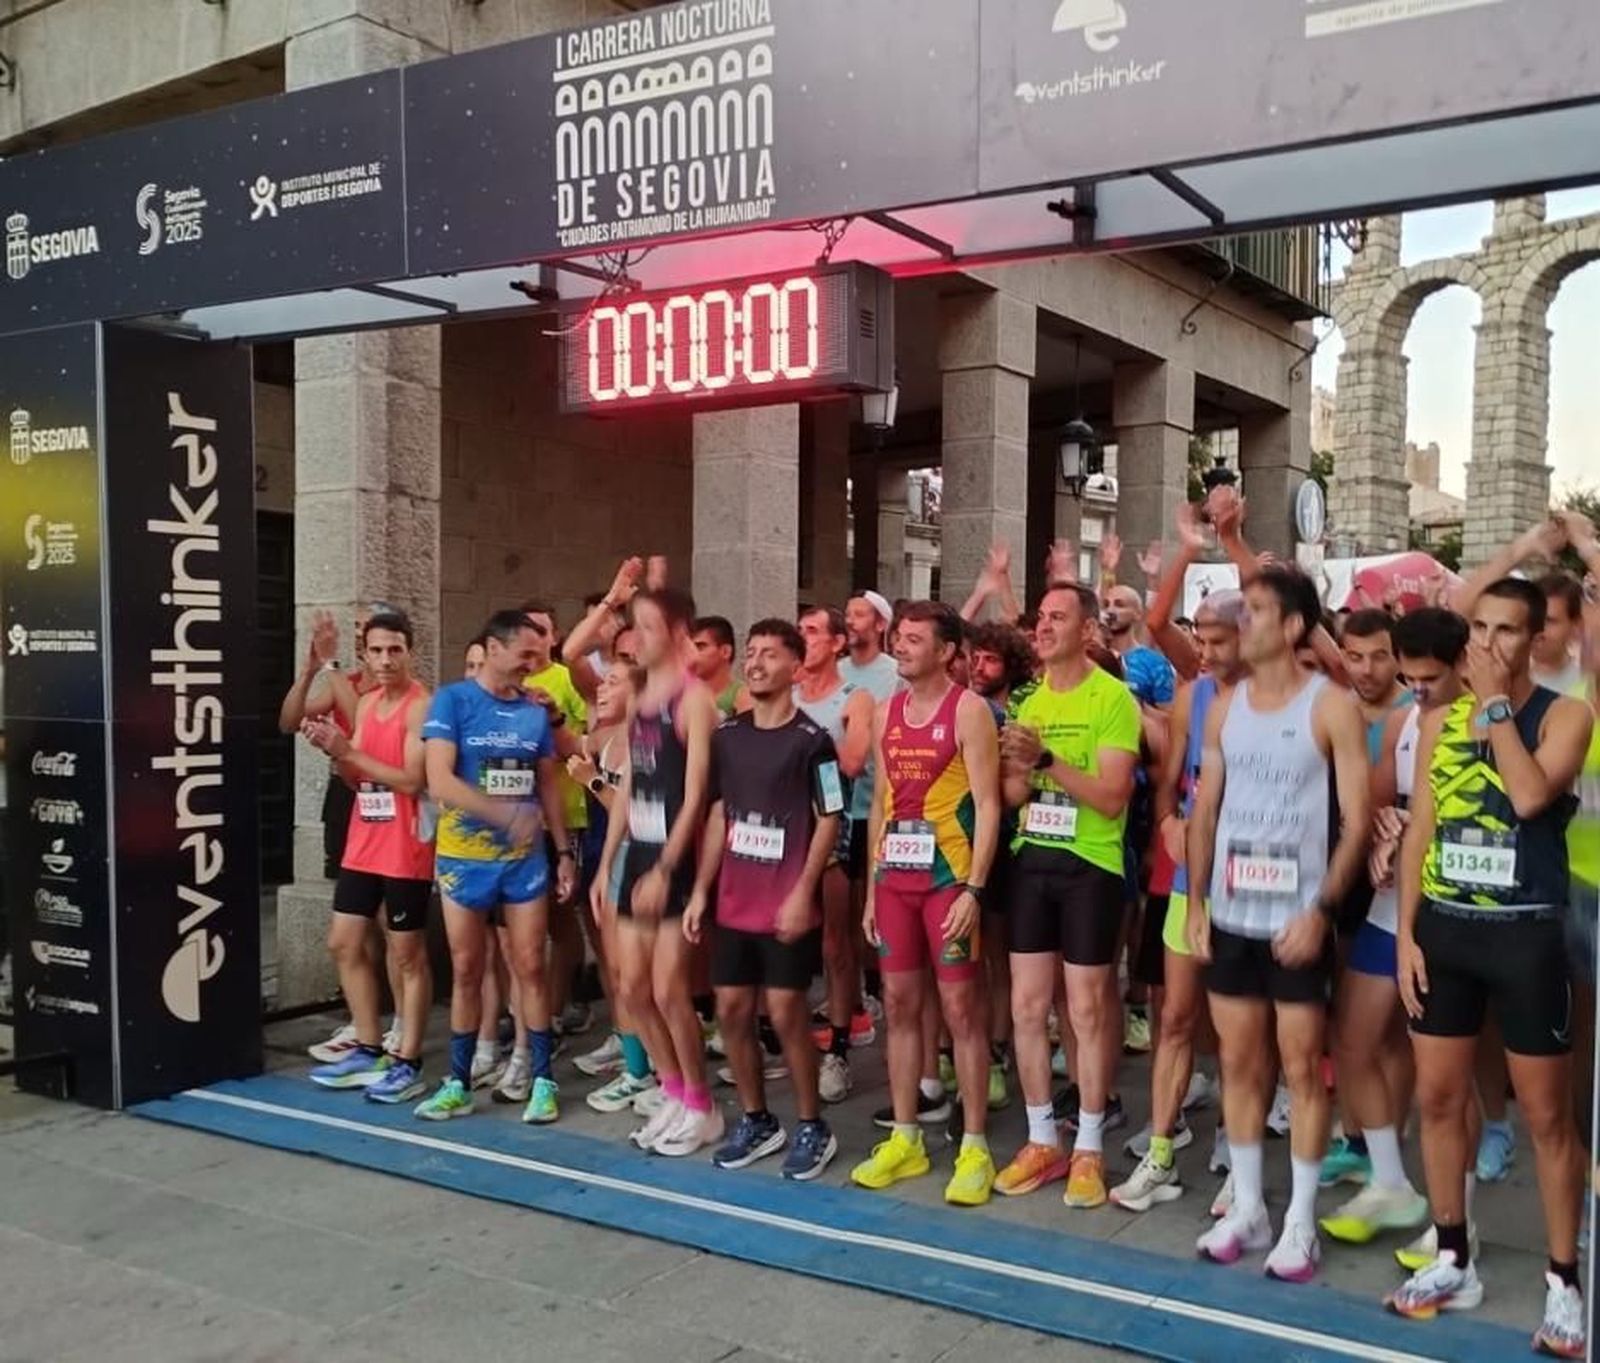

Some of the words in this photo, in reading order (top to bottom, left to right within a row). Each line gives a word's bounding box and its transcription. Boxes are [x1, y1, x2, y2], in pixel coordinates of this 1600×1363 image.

[556, 37, 562, 69] I
[567, 16, 655, 66] CARRERA
[661, 0, 771, 46] NOCTURNA
[1015, 60, 1167, 103] eventsthinker
[323, 164, 368, 183] MUNICIPAL
[368, 162, 380, 175] DE
[281, 186, 330, 208] DEPORTES
[337, 177, 382, 197] SEGOVIA
[558, 179, 596, 227] DE
[617, 149, 775, 218] SEGOVIA
[165, 220, 203, 244] 2025
[610, 217, 671, 239] PATRIMONIO
[674, 211, 687, 230] DE
[689, 208, 703, 228] LA
[31, 225, 99, 264] SEGOVIA
[588, 276, 818, 401] 00:00:00
[31, 426, 90, 453] SEGOVIA
[147, 391, 226, 1022] eventsthinker
[490, 775, 523, 789] 5129
[1030, 809, 1062, 826] 1352
[889, 840, 921, 855] 1292
[1240, 863, 1280, 881] 1039
[1446, 852, 1493, 874] 5134
